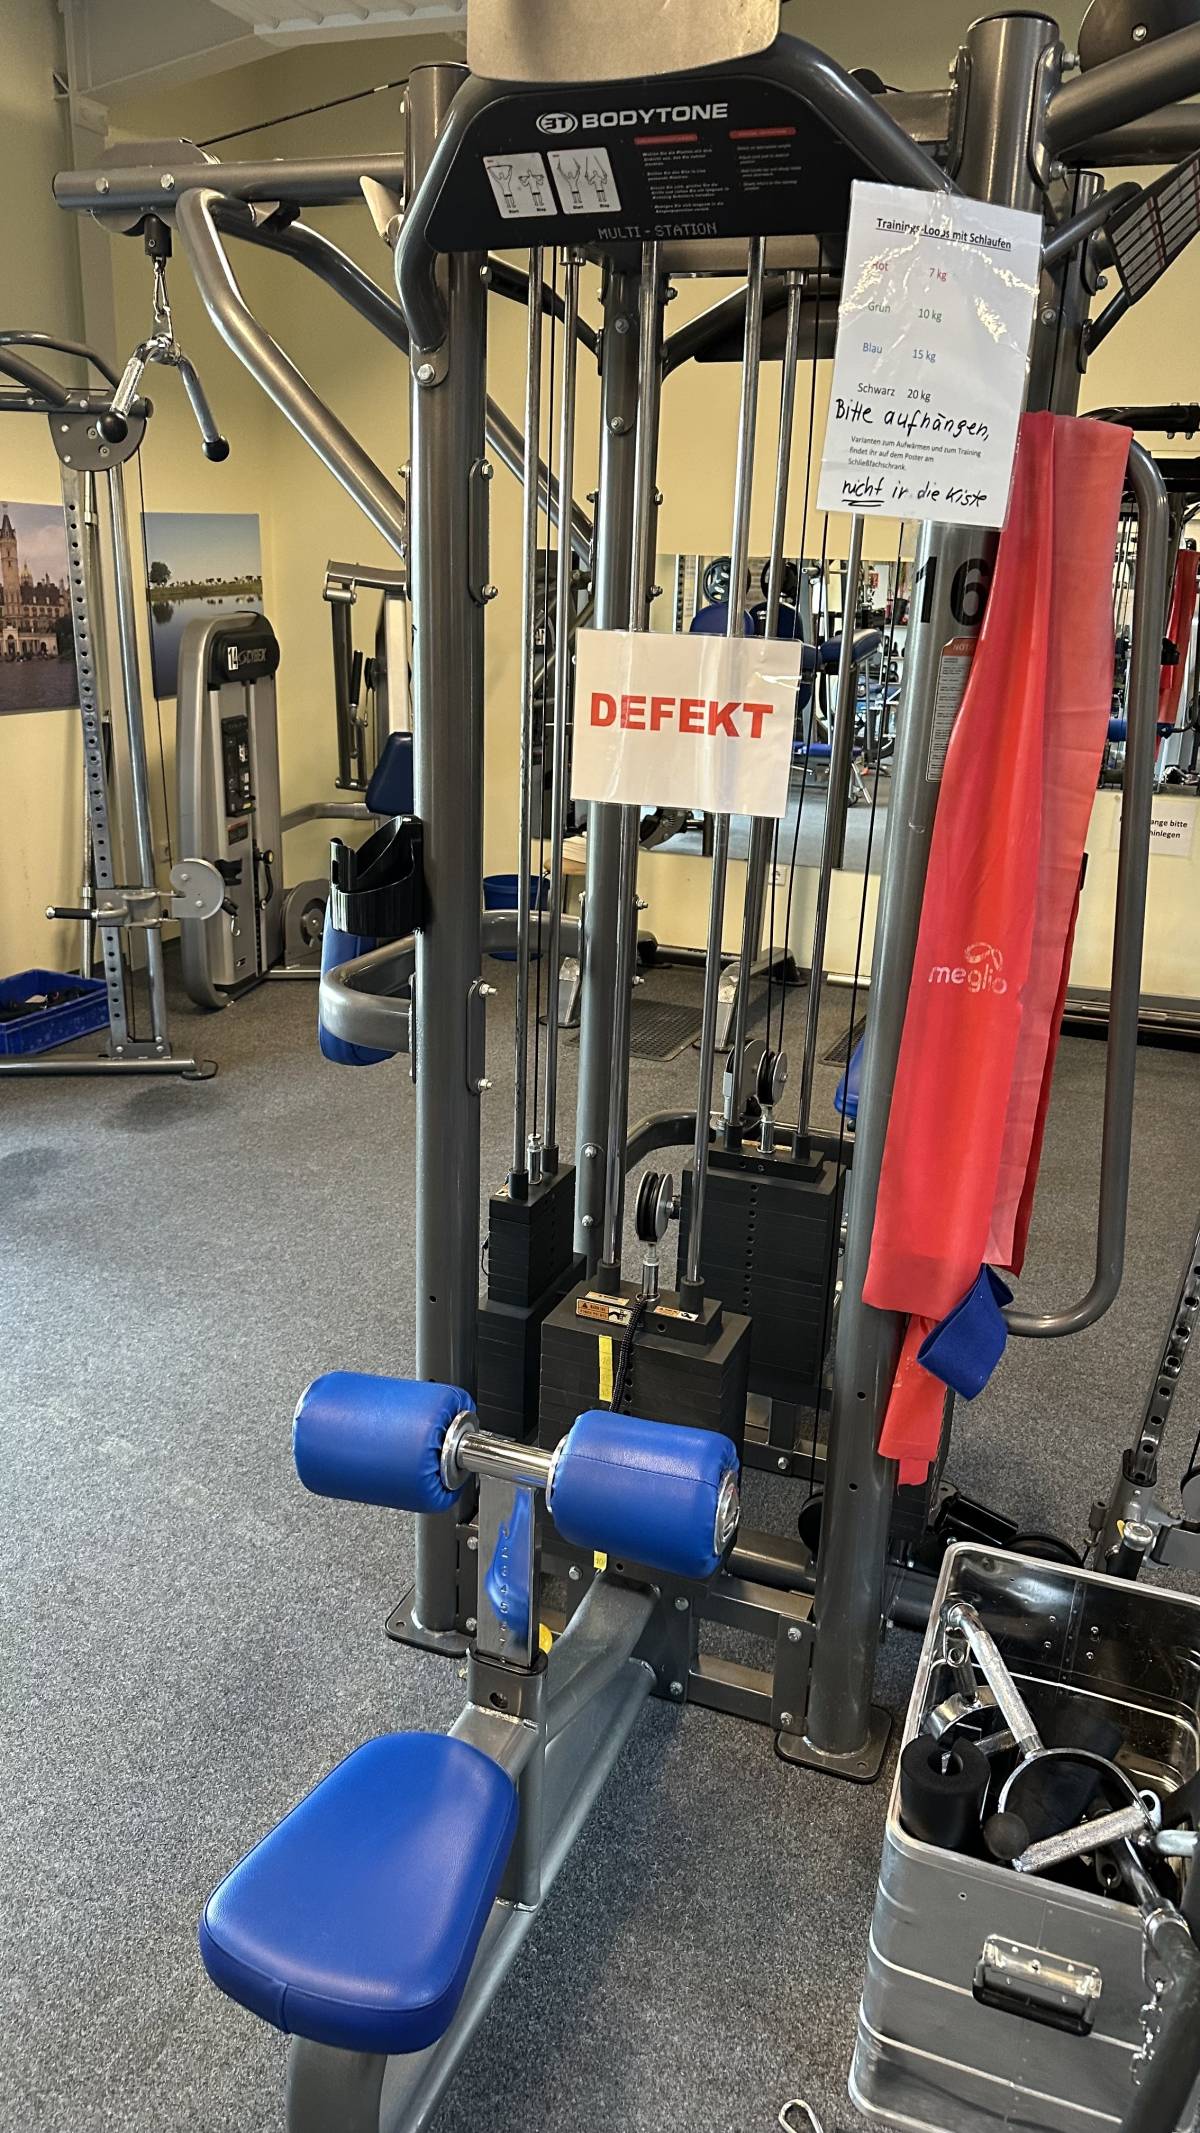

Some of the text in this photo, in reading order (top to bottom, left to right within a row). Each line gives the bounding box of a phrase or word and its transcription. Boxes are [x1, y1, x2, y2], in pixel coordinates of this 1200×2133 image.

[582, 103, 729, 129] BODYTONE
[952, 230, 968, 242] mit
[969, 232, 1012, 250] Schlaufen
[929, 268, 936, 278] 7
[937, 268, 947, 282] kg
[919, 308, 930, 319] 10
[931, 310, 942, 323] kg
[863, 342, 936, 364] Blau 15 kg
[857, 383, 931, 403] Schwarz 20 kg
[835, 398, 874, 424] Bitte
[849, 446, 868, 456] findet
[869, 449, 878, 457] ihr
[879, 450, 890, 459] auf
[890, 451, 904, 460] dem
[904, 452, 924, 463] Poster
[851, 436, 881, 446] Varianten
[882, 440, 895, 448] zum
[896, 440, 931, 451] Aufwärmen
[931, 444, 943, 453] und
[958, 447, 982, 459] Training
[842, 476, 885, 498] nicht
[917, 480, 940, 502] die
[945, 486, 988, 507] Kiste
[915, 556, 992, 627] 16
[590, 692, 774, 739] DEFEKT
[1170, 819, 1188, 828] bitte
[928, 963, 1008, 995] meglio
[500, 1583, 508, 1595] 4
[500, 1602, 509, 1614] 5
